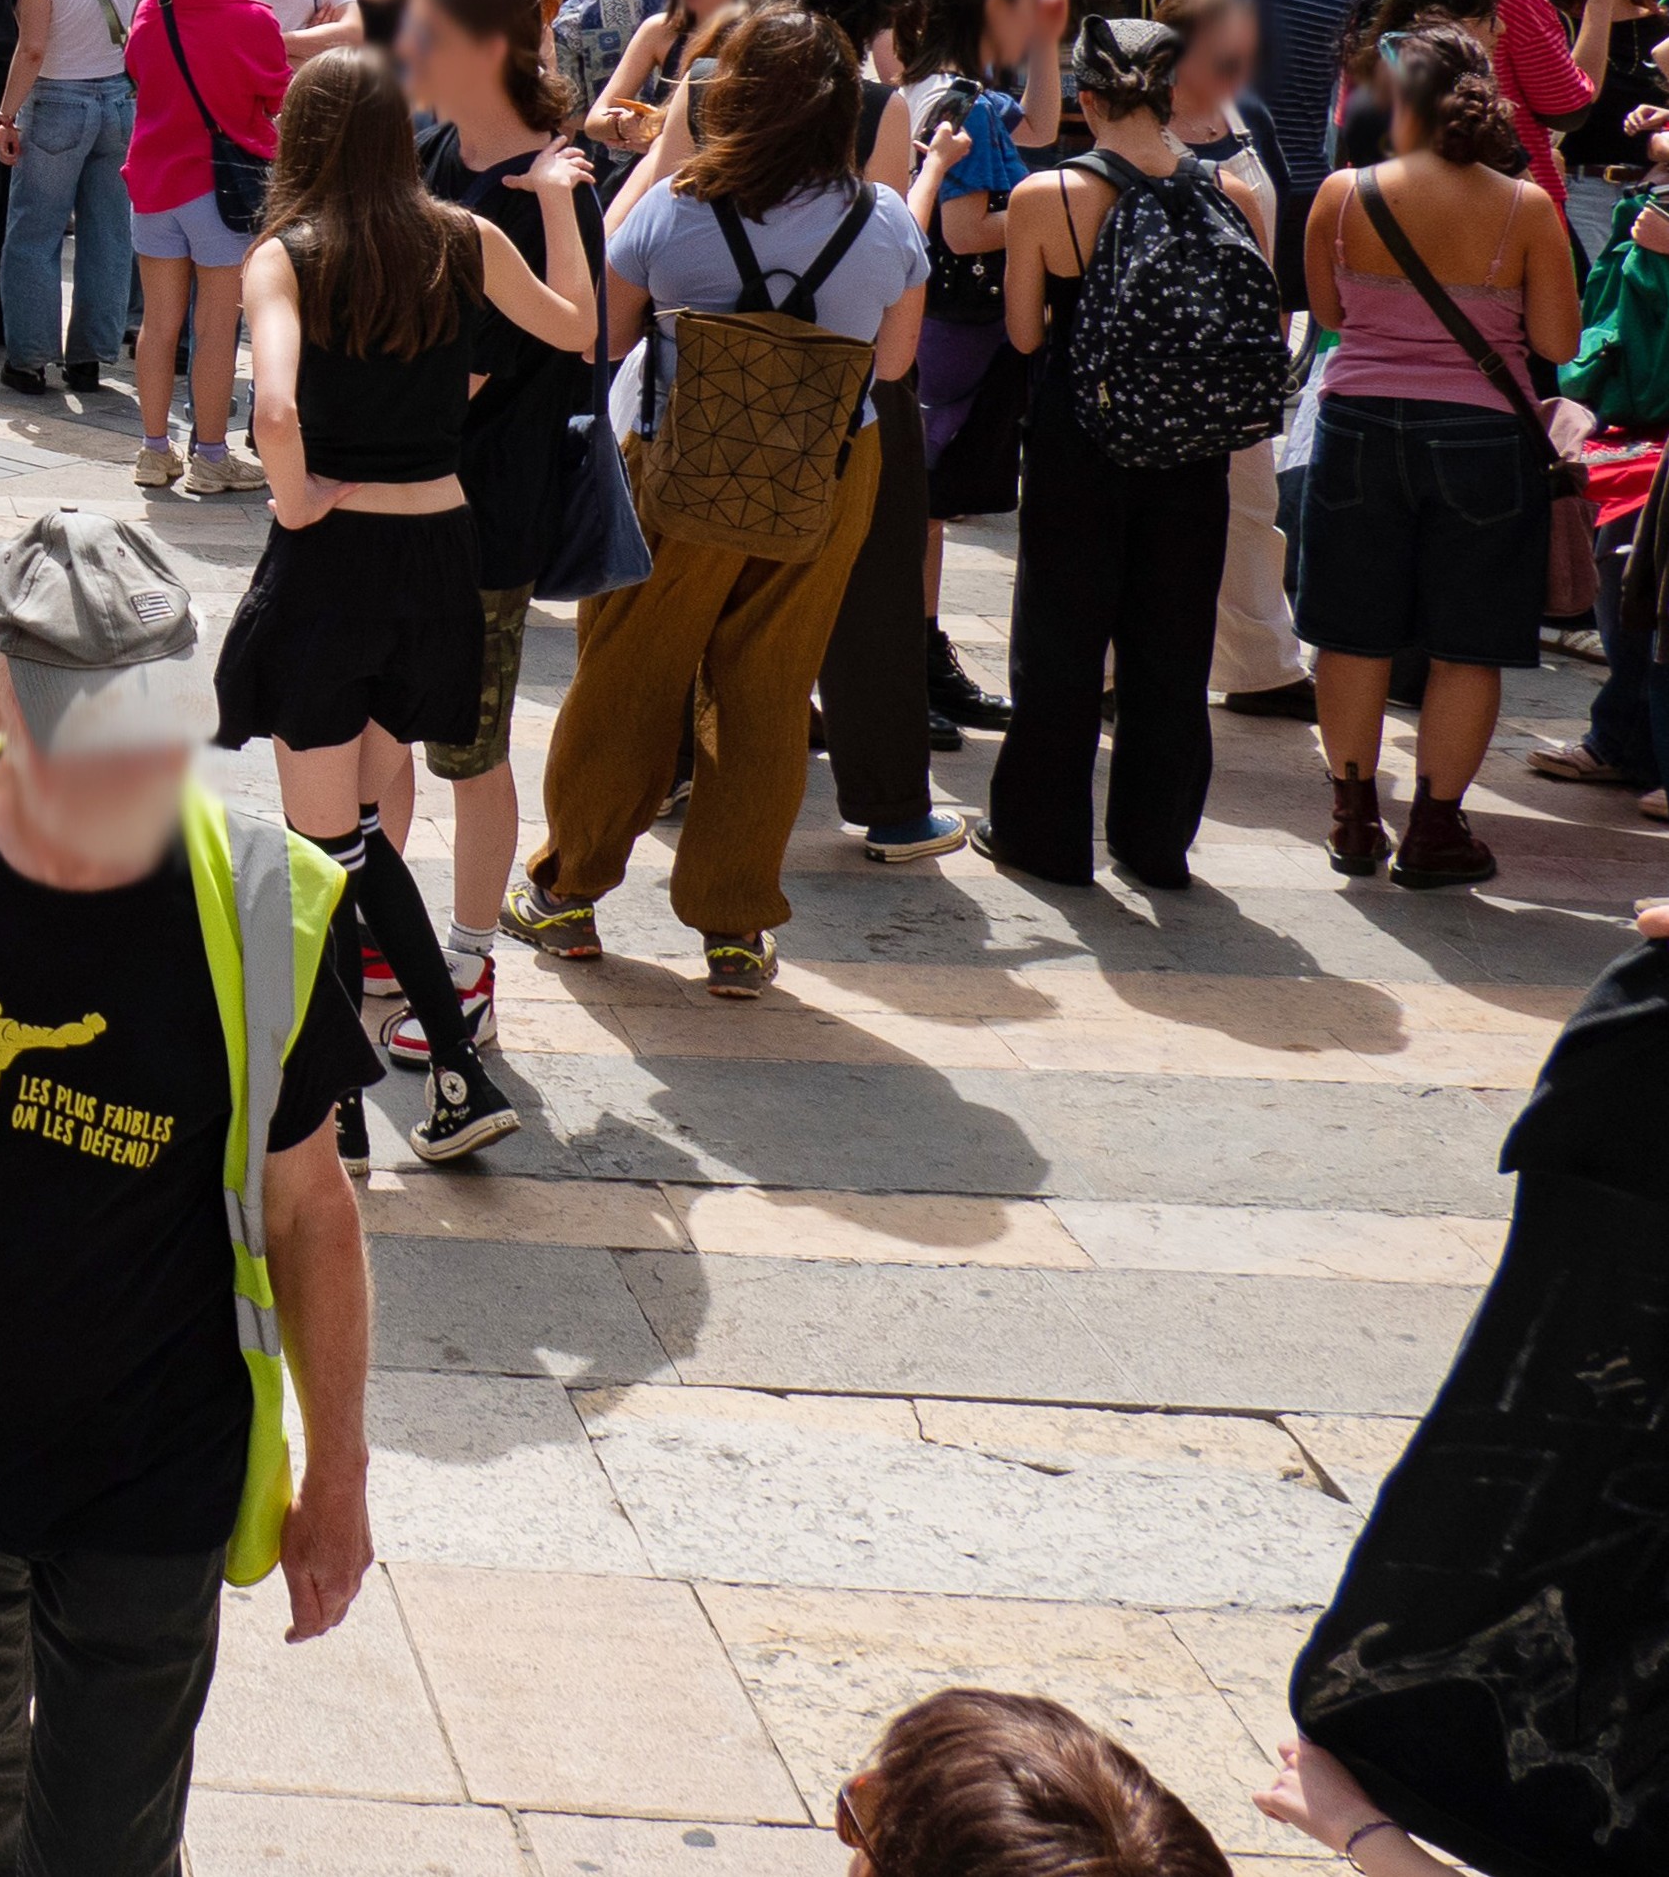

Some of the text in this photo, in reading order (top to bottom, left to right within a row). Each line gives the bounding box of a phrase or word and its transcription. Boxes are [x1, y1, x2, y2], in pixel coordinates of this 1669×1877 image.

[18, 1074, 52, 1106] LES
[54, 1084, 98, 1123] PLUS
[11, 1103, 38, 1131] ON
[42, 1109, 75, 1146] LES
